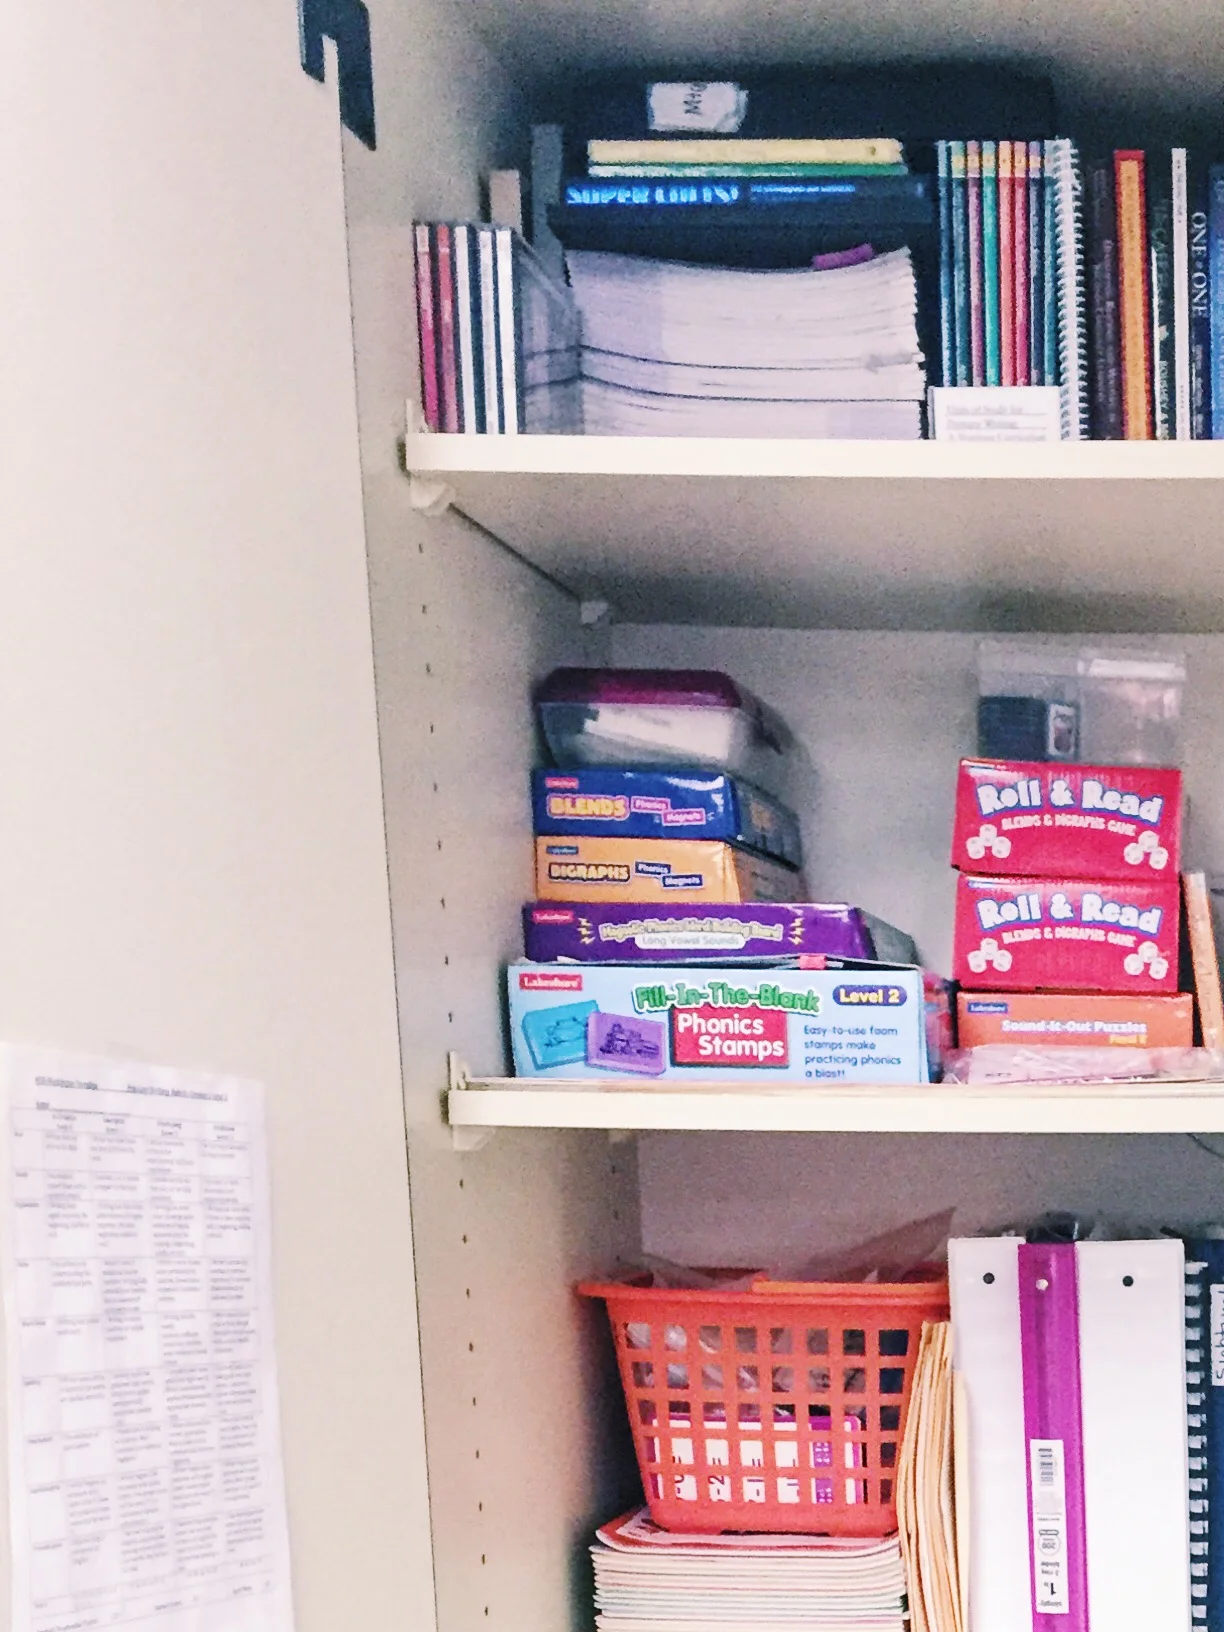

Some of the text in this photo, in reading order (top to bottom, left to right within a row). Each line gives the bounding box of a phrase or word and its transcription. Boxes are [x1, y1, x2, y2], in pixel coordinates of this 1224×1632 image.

[1191, 212, 1207, 258] ONE
[550, 796, 626, 818] BLENDS
[634, 799, 668, 811] Phonics
[976, 779, 1164, 824] Roll & Read
[550, 864, 629, 880] DIGRAPHS
[637, 864, 669, 874] Phonics
[976, 893, 1163, 935] Roll & Read
[642, 934, 740, 950] Long Vowel Sounds
[524, 976, 579, 988] Lakeshore
[634, 982, 821, 1012] Fill-In-The-Blank
[839, 987, 900, 1004] Level 2
[677, 1013, 764, 1036] Phonics
[869, 1025, 899, 1037] foam
[1094, 1020, 1147, 1034] Puzzles
[698, 1035, 785, 1062] Stamps
[804, 1039, 876, 1052] stamps make
[804, 1053, 902, 1068] practicing phonics
